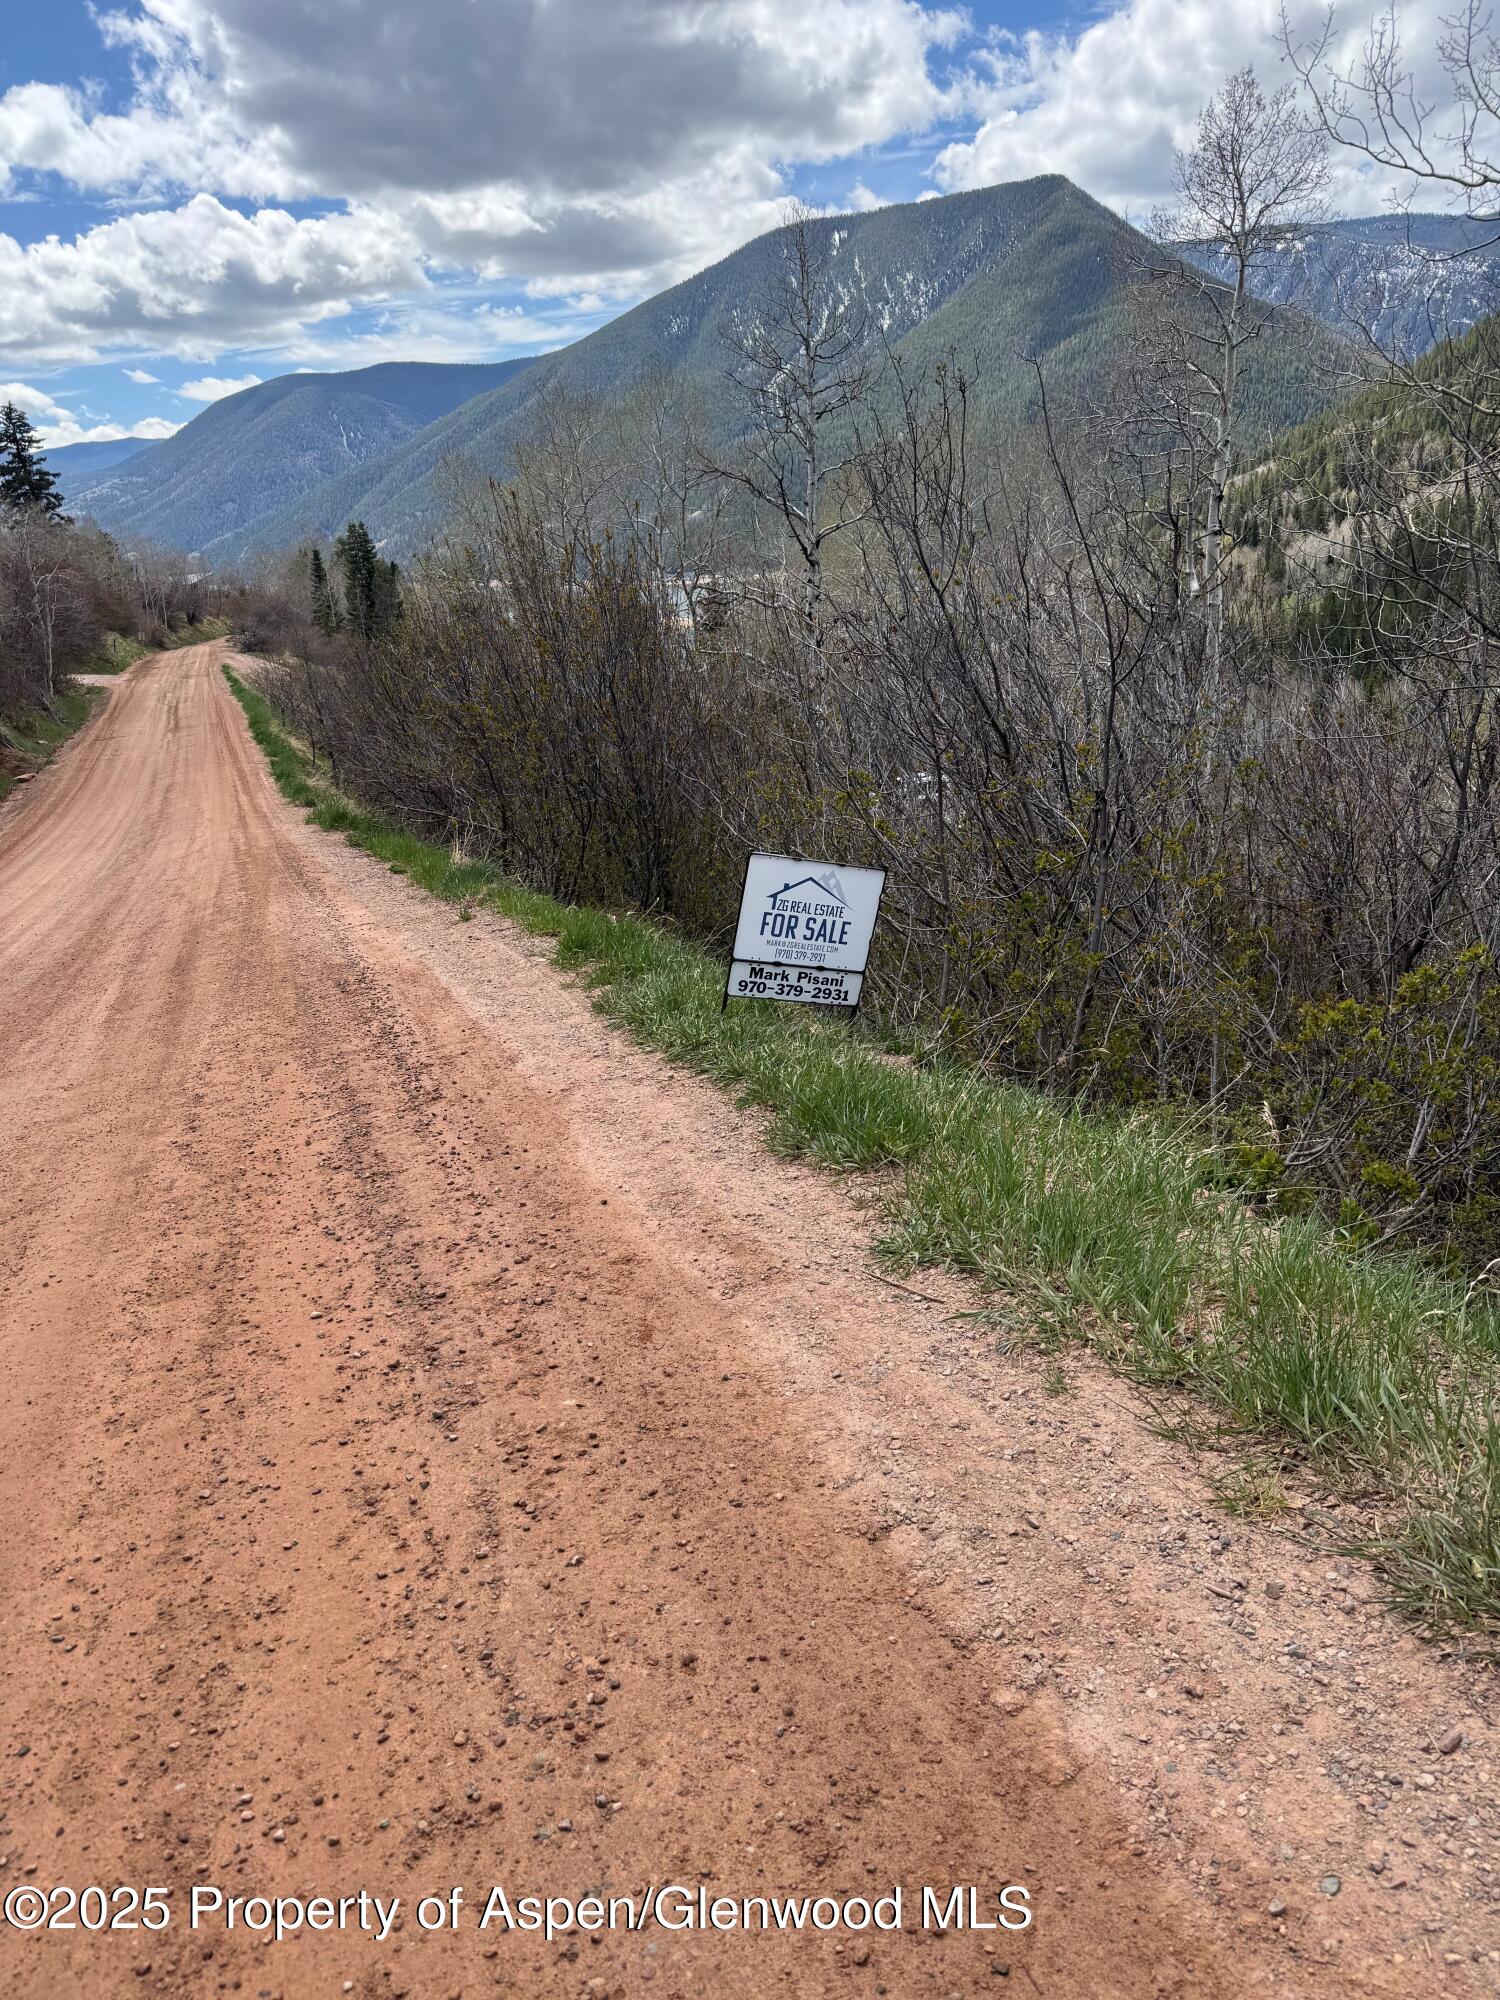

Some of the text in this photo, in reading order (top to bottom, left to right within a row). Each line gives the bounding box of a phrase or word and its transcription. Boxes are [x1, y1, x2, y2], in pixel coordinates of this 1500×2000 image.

[777, 899, 845, 918] ZG REAL ESTATE
[760, 912, 851, 945] FOR SALE
[775, 949, 826, 962] (970) 379-2931
[749, 967, 844, 987] Mark Pisani
[738, 980, 849, 1001] 970-379-2931
